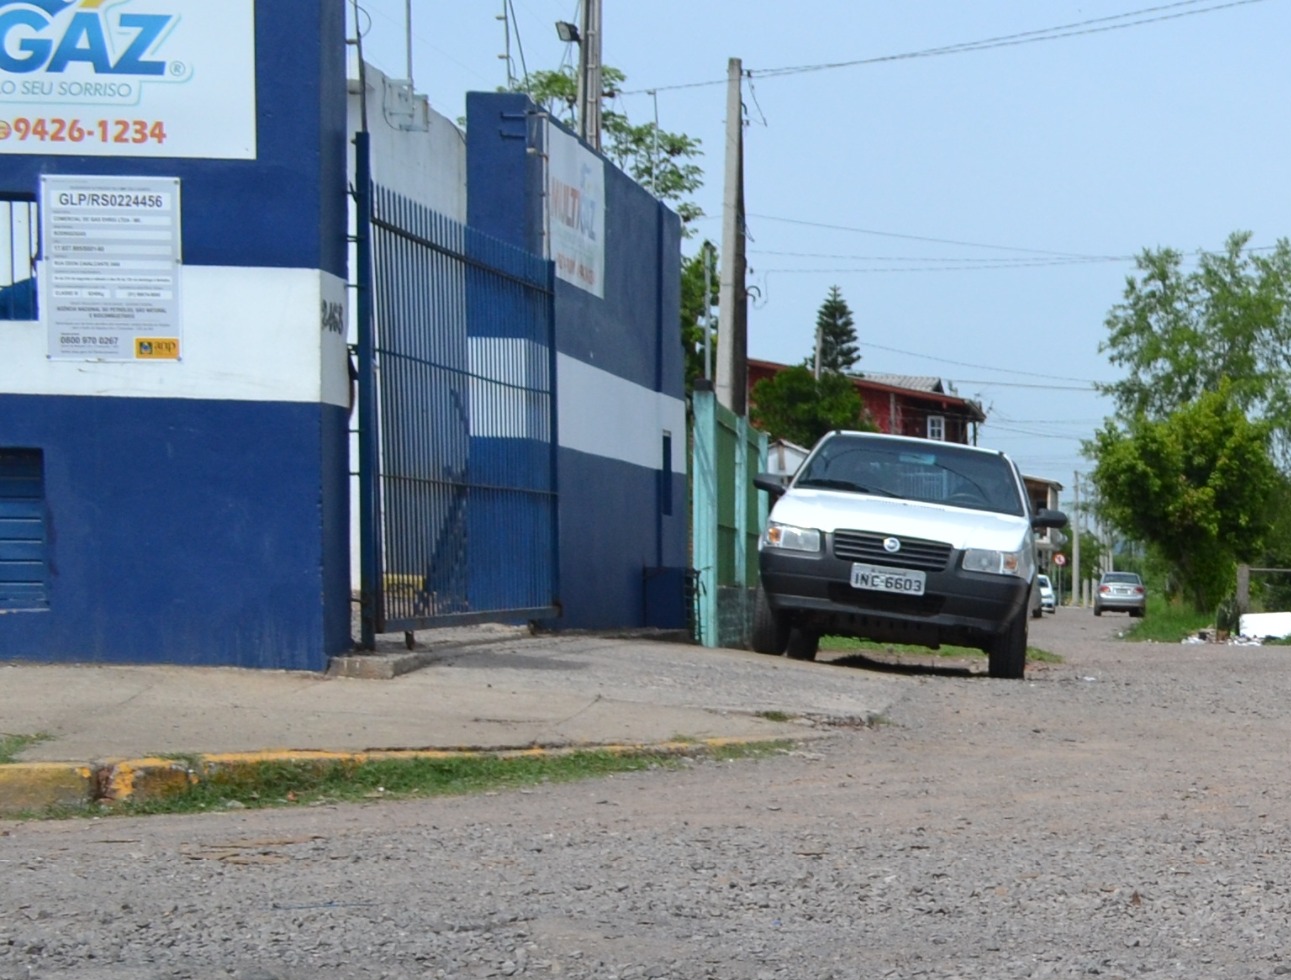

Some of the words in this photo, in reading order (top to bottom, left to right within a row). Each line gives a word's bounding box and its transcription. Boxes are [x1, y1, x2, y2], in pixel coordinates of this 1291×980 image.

[21, 81, 54, 96] SEU
[58, 82, 132, 98] SORRISO
[13, 117, 167, 144] 9426-1234
[59, 193, 163, 208] GLP/RS0224456
[60, 336, 81, 345] 0800
[82, 336, 97, 345] 970
